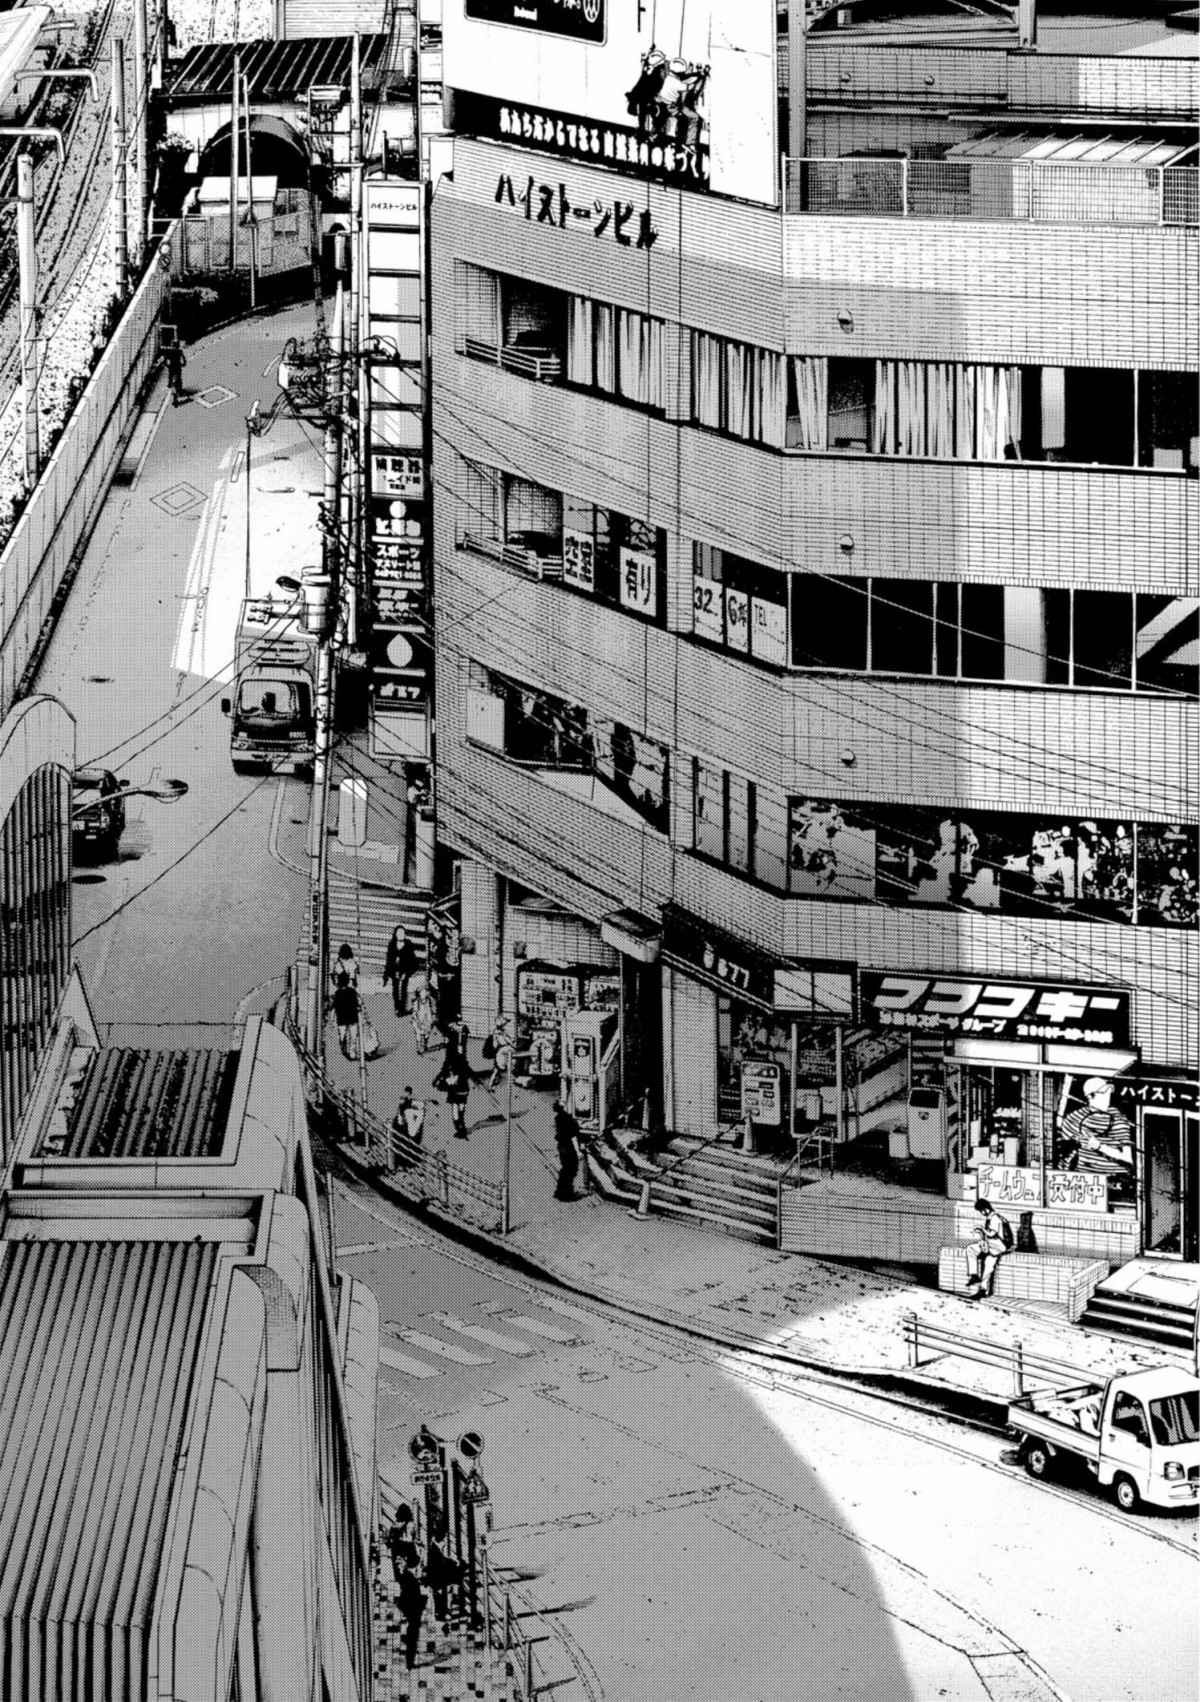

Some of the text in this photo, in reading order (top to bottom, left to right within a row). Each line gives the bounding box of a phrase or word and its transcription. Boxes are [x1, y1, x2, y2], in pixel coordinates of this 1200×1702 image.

[371, 202, 418, 211] ハイストーンビル
[495, 174, 660, 249] ハイストーンビル
[626, 558, 651, 605] 有り
